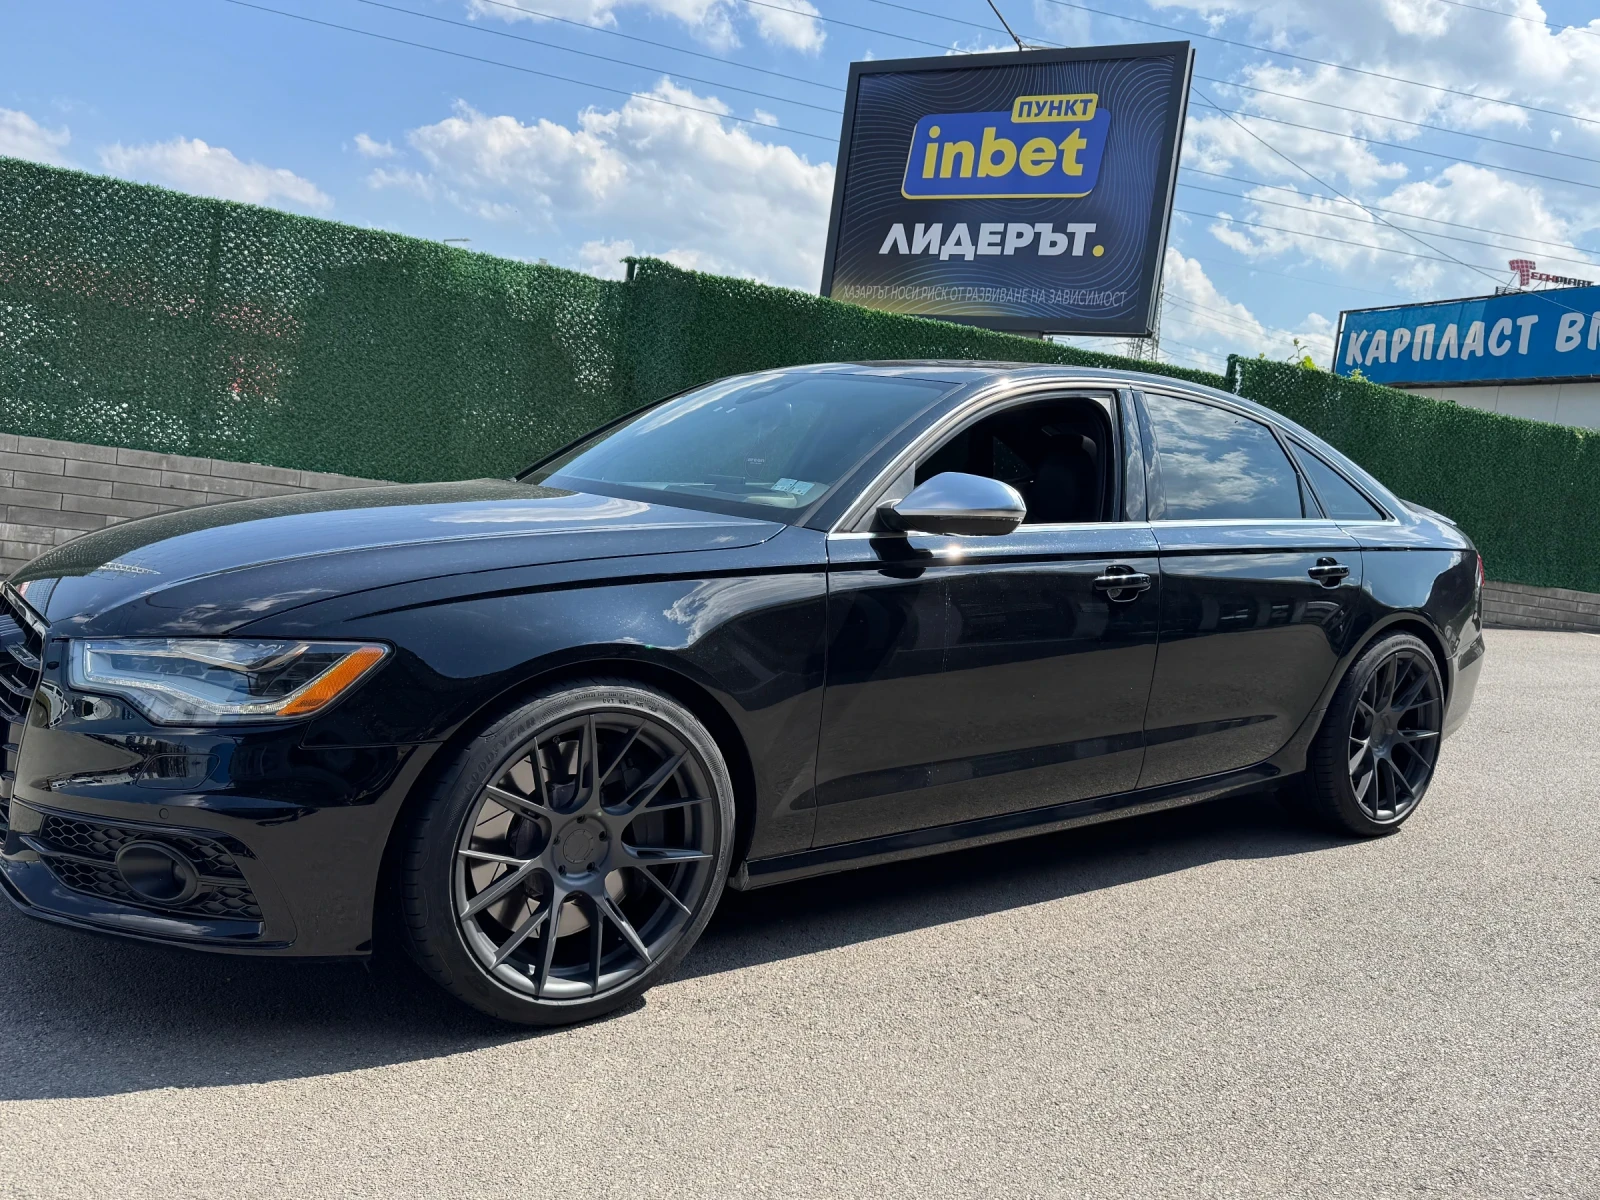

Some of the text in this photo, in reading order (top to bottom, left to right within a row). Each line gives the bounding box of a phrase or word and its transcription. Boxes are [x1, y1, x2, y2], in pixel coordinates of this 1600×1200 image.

[1017, 98, 1093, 118] ПУНКТ
[922, 125, 1088, 179] inbet
[879, 222, 1105, 261] ЛИДЕРЪТ.
[843, 285, 1127, 307] ХАЗАРТЪТ НОСИ РИСК ОТ РАЗВИВАНЕ НА ЗАВИСИМОСТ
[1345, 314, 1539, 367] КАРПЛАСТ
